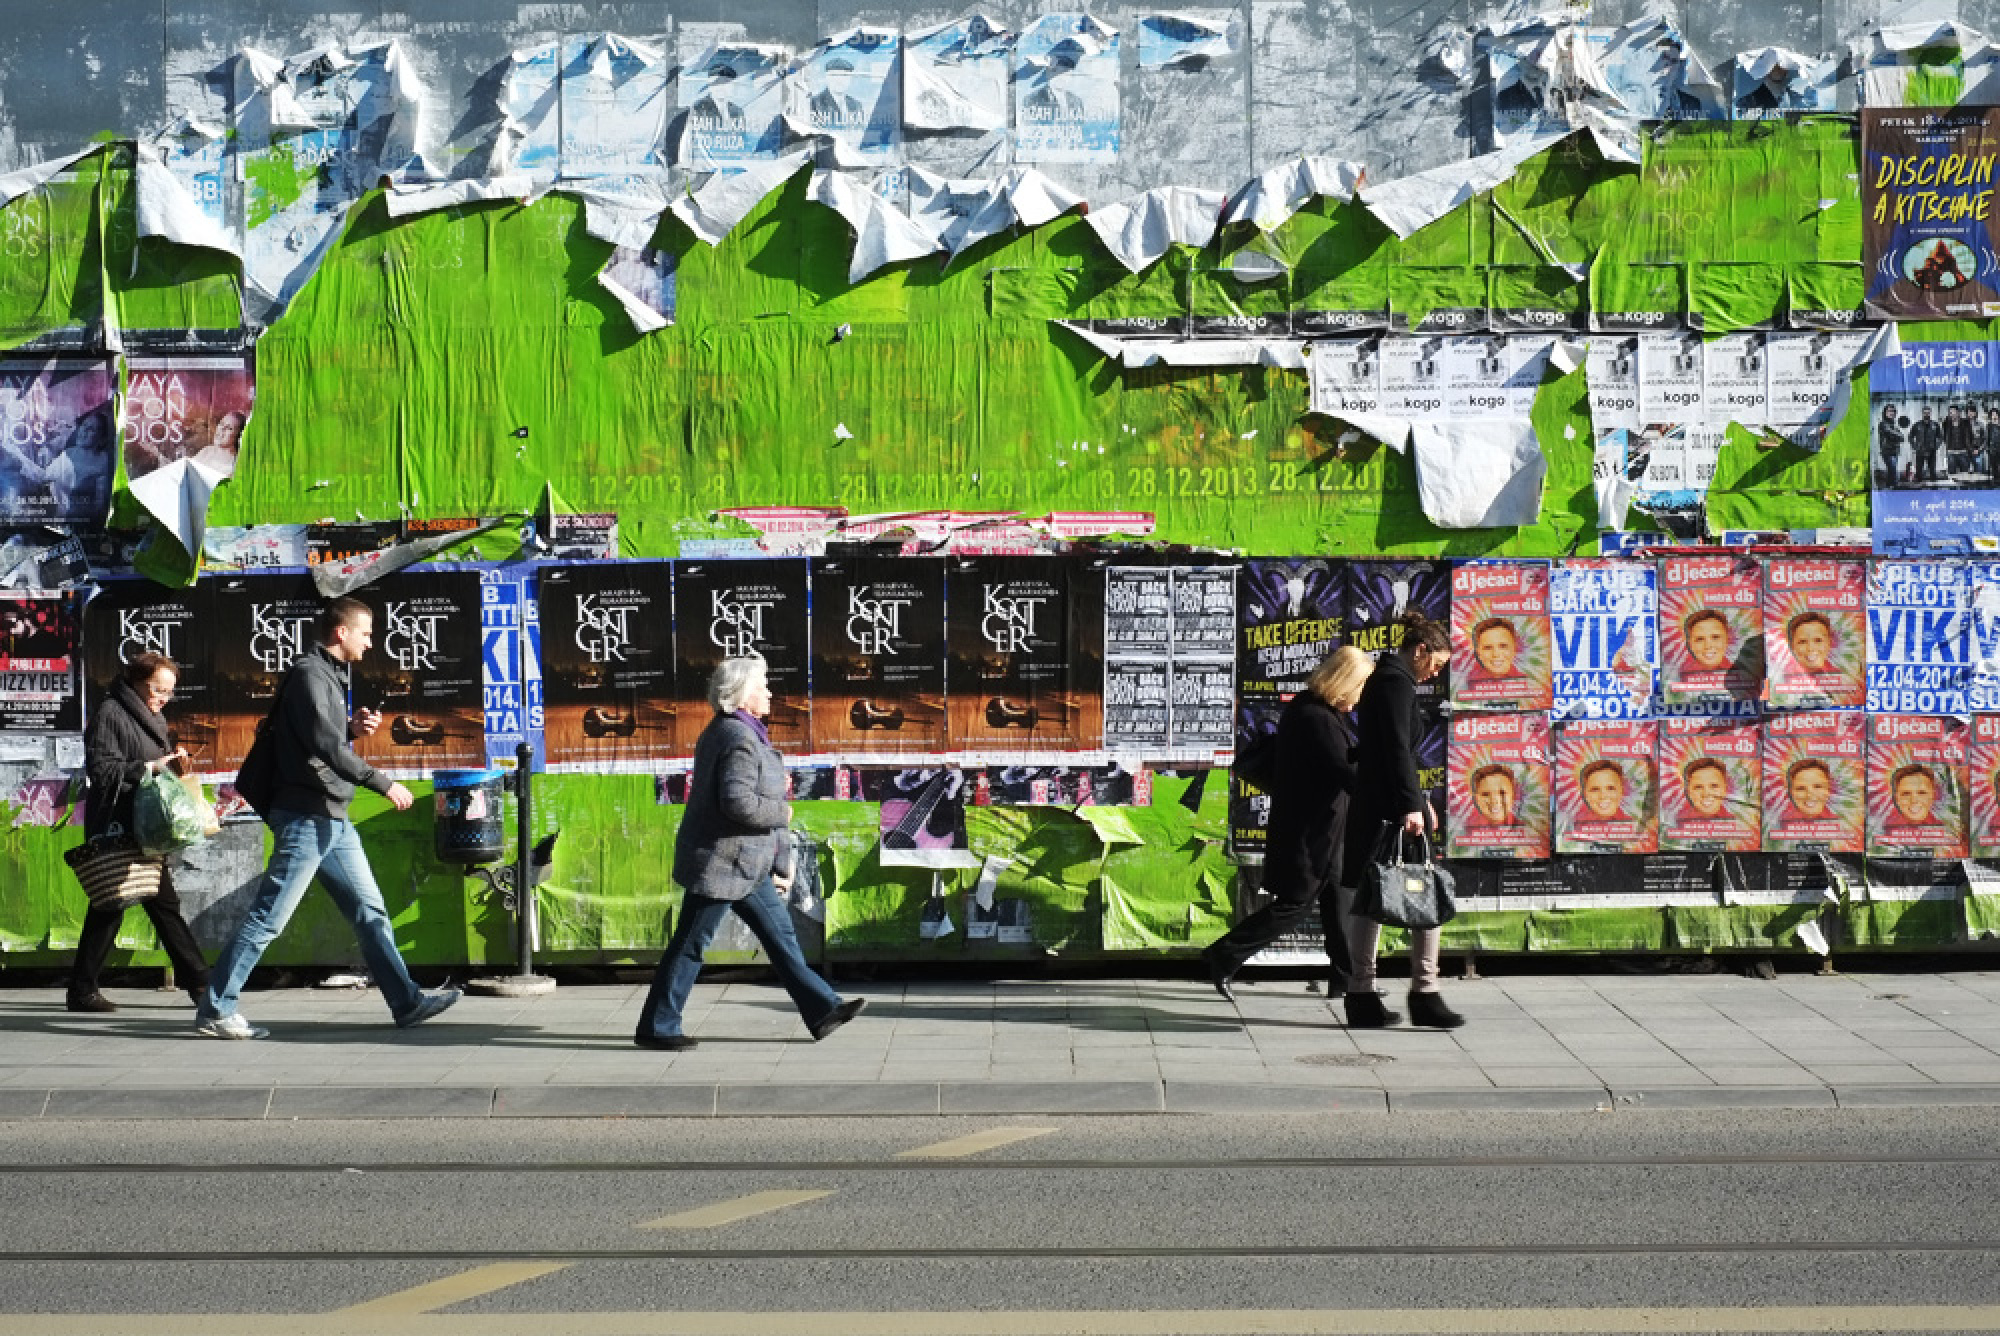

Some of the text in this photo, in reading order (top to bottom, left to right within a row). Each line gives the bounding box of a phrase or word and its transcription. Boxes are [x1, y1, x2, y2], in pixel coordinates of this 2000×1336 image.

[1875, 152, 1997, 190] DISCIPLIN
[1873, 191, 1887, 225] A
[1228, 314, 1267, 331] kogo
[1327, 311, 1366, 328] kogo
[1525, 310, 1566, 326] kogo
[1624, 310, 1665, 324] kogo
[1901, 349, 1986, 368] BOLERO
[1341, 397, 1377, 413] kogo
[1404, 397, 1441, 413] kogo
[1469, 394, 1505, 410] kogo
[1597, 395, 1635, 411] kogo
[1664, 391, 1701, 407] kogo
[1728, 392, 1765, 408] kogo
[1792, 391, 1830, 407] kogo
[1127, 467, 1265, 498] 28.12.2013.
[1522, 597, 1542, 612] db
[1838, 592, 1858, 607] db
[1244, 624, 1282, 649] TAKE
[1285, 617, 1344, 646] OFFENSE
[1349, 625, 1388, 651] TAKE
[1868, 608, 1972, 664] VIKI
[0, 673, 69, 691] IZZY DEE
[1867, 689, 1969, 713] SUBOTA
[1735, 738, 1755, 752] db
[1838, 739, 1858, 753] db
